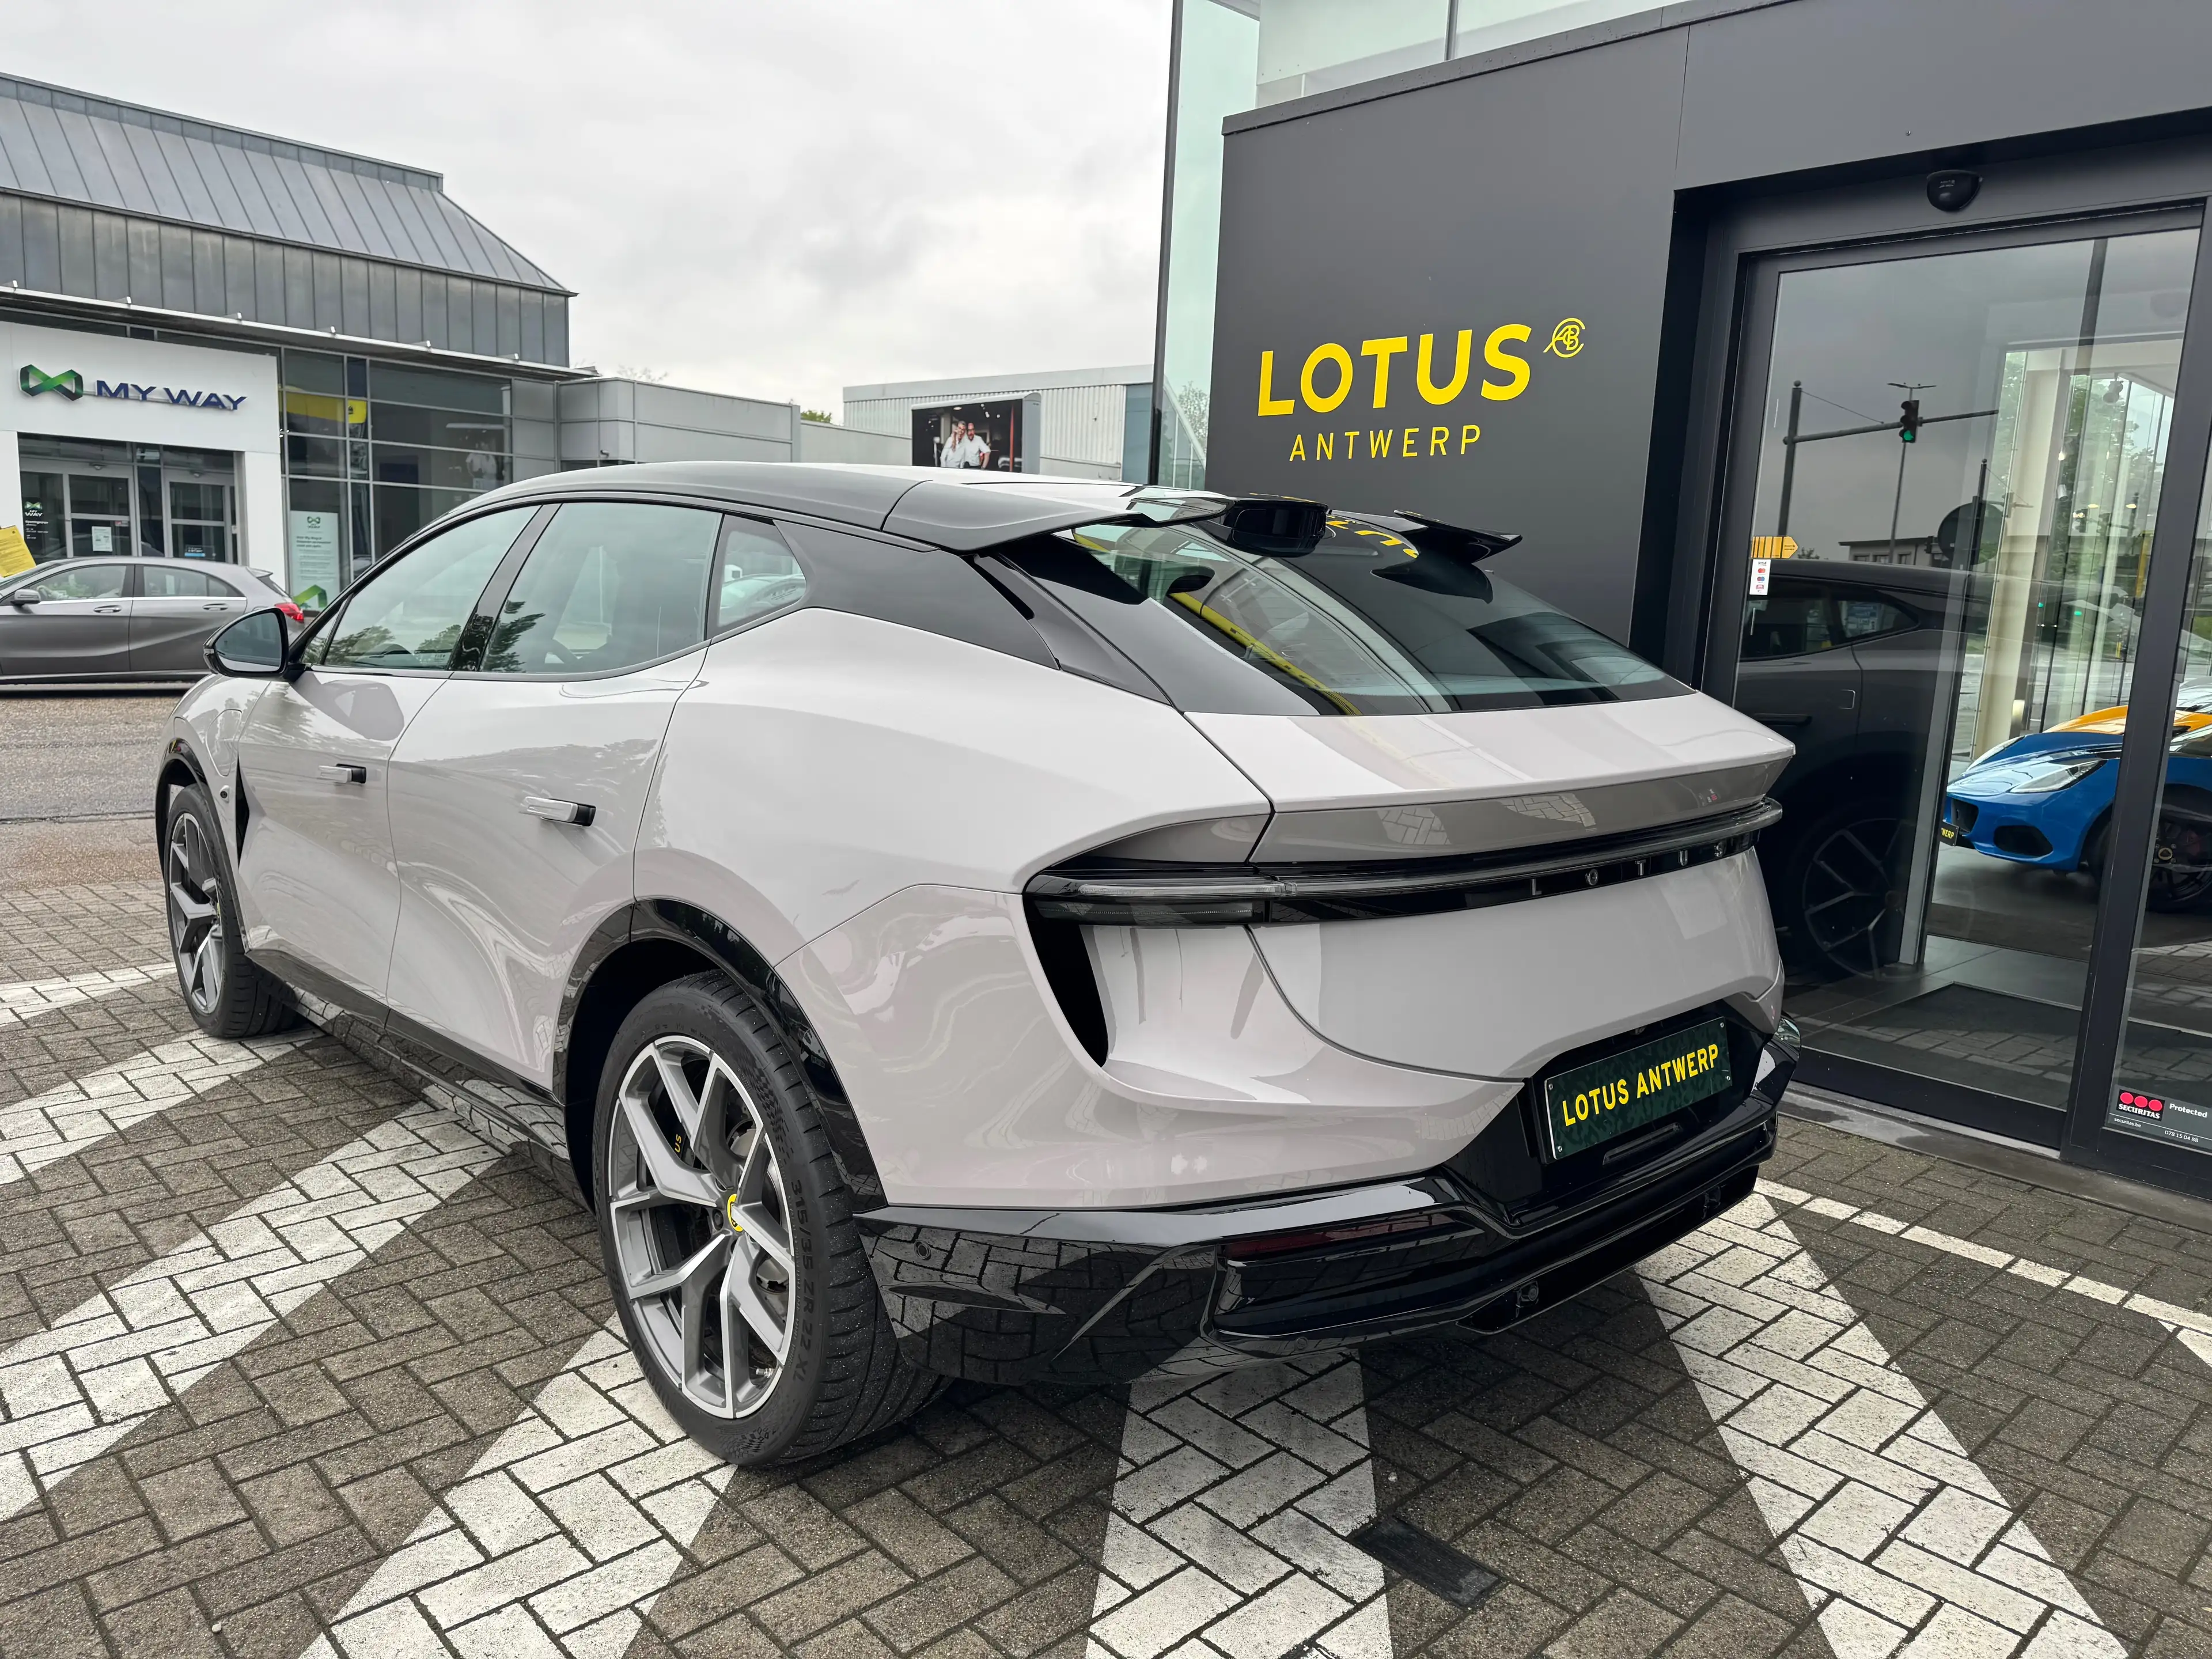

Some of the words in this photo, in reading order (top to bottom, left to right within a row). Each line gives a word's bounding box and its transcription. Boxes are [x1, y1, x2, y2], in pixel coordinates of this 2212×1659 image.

[1258, 324, 1532, 416] LOTUS
[96, 380, 157, 401] MY
[163, 387, 247, 410] WAY
[1289, 425, 1480, 461] ANTWERP
[1941, 828, 1955, 839] WERP
[1531, 842, 1726, 896] LOTUS
[1562, 1078, 1630, 1127] LOTUS
[1637, 1044, 1718, 1099] ANTWERP
[2113, 1117, 2142, 1128] securitas.be
[2118, 1103, 2160, 1119] SECURITAS
[2169, 1103, 2208, 1118] Protected
[791, 1179, 814, 1270] 315/35
[803, 1278, 815, 1314] ZR
[800, 1319, 813, 1351] 22
